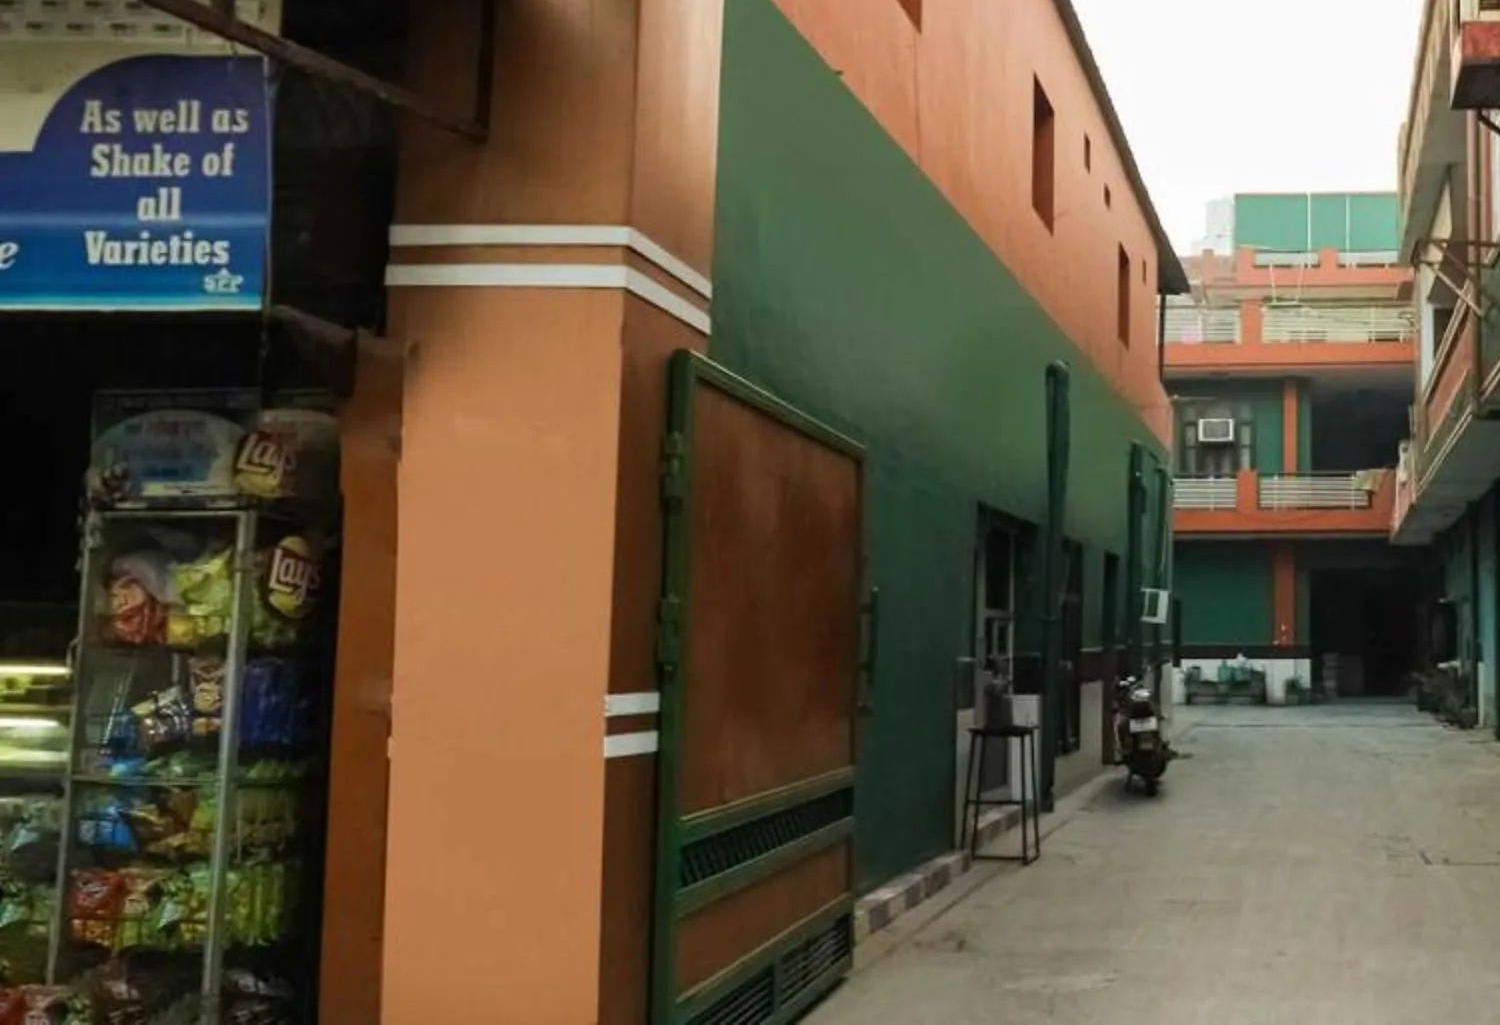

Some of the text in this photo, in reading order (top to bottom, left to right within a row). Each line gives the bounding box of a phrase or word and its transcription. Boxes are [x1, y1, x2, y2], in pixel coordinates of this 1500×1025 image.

[80, 100, 249, 134] As well as
[90, 143, 235, 178] Shake of
[137, 187, 181, 222] all
[85, 230, 230, 265] Varieties
